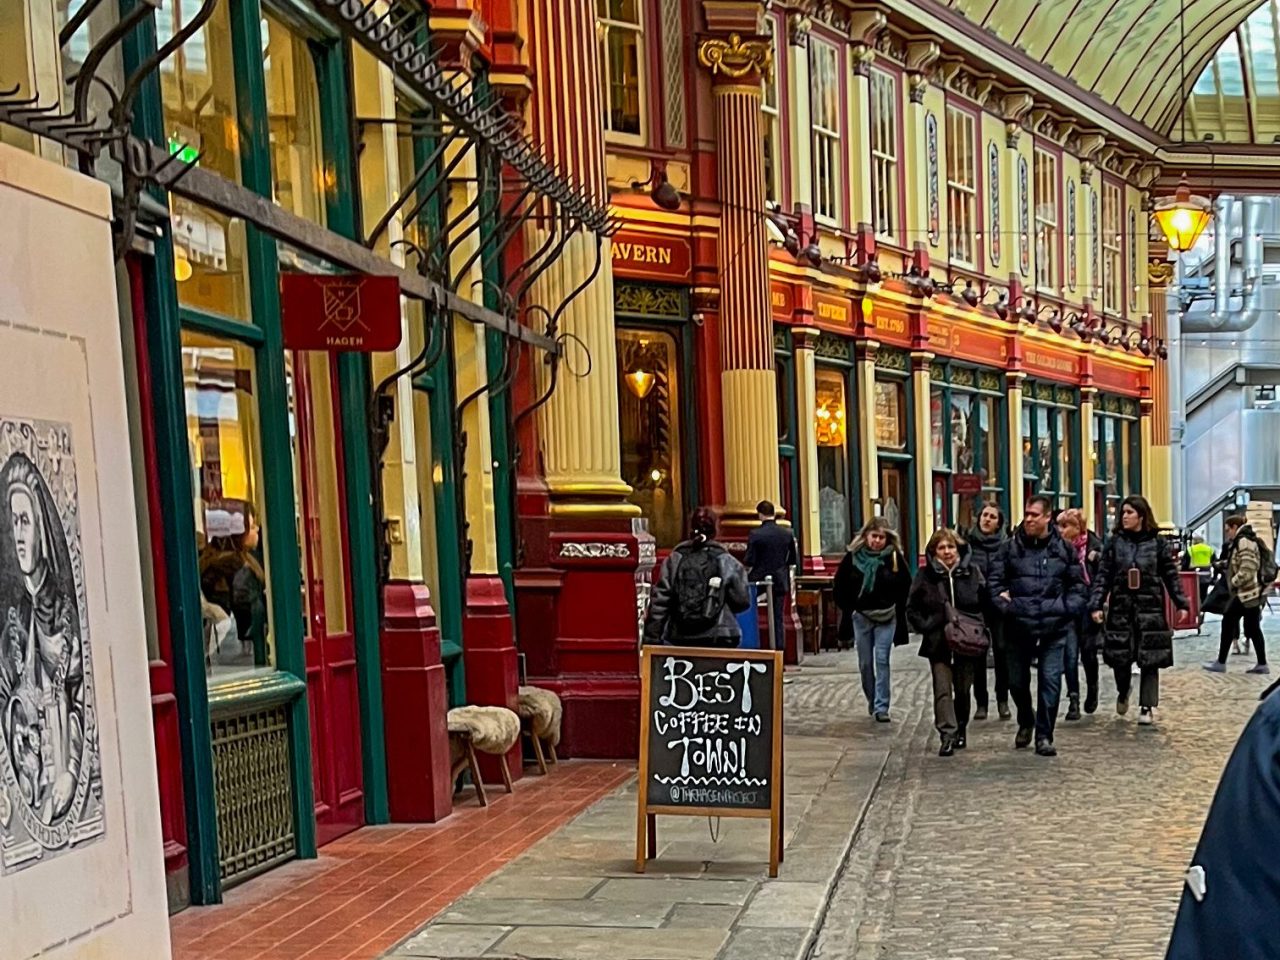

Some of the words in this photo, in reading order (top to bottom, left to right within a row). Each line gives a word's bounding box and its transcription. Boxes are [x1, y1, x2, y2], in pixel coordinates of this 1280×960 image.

[611, 242, 671, 265] AVERN
[326, 336, 364, 346] HAGEN
[659, 656, 767, 713] BEST
[654, 710, 729, 735] COFFEE
[734, 714, 761, 736] IN
[667, 736, 746, 778] TOWN!
